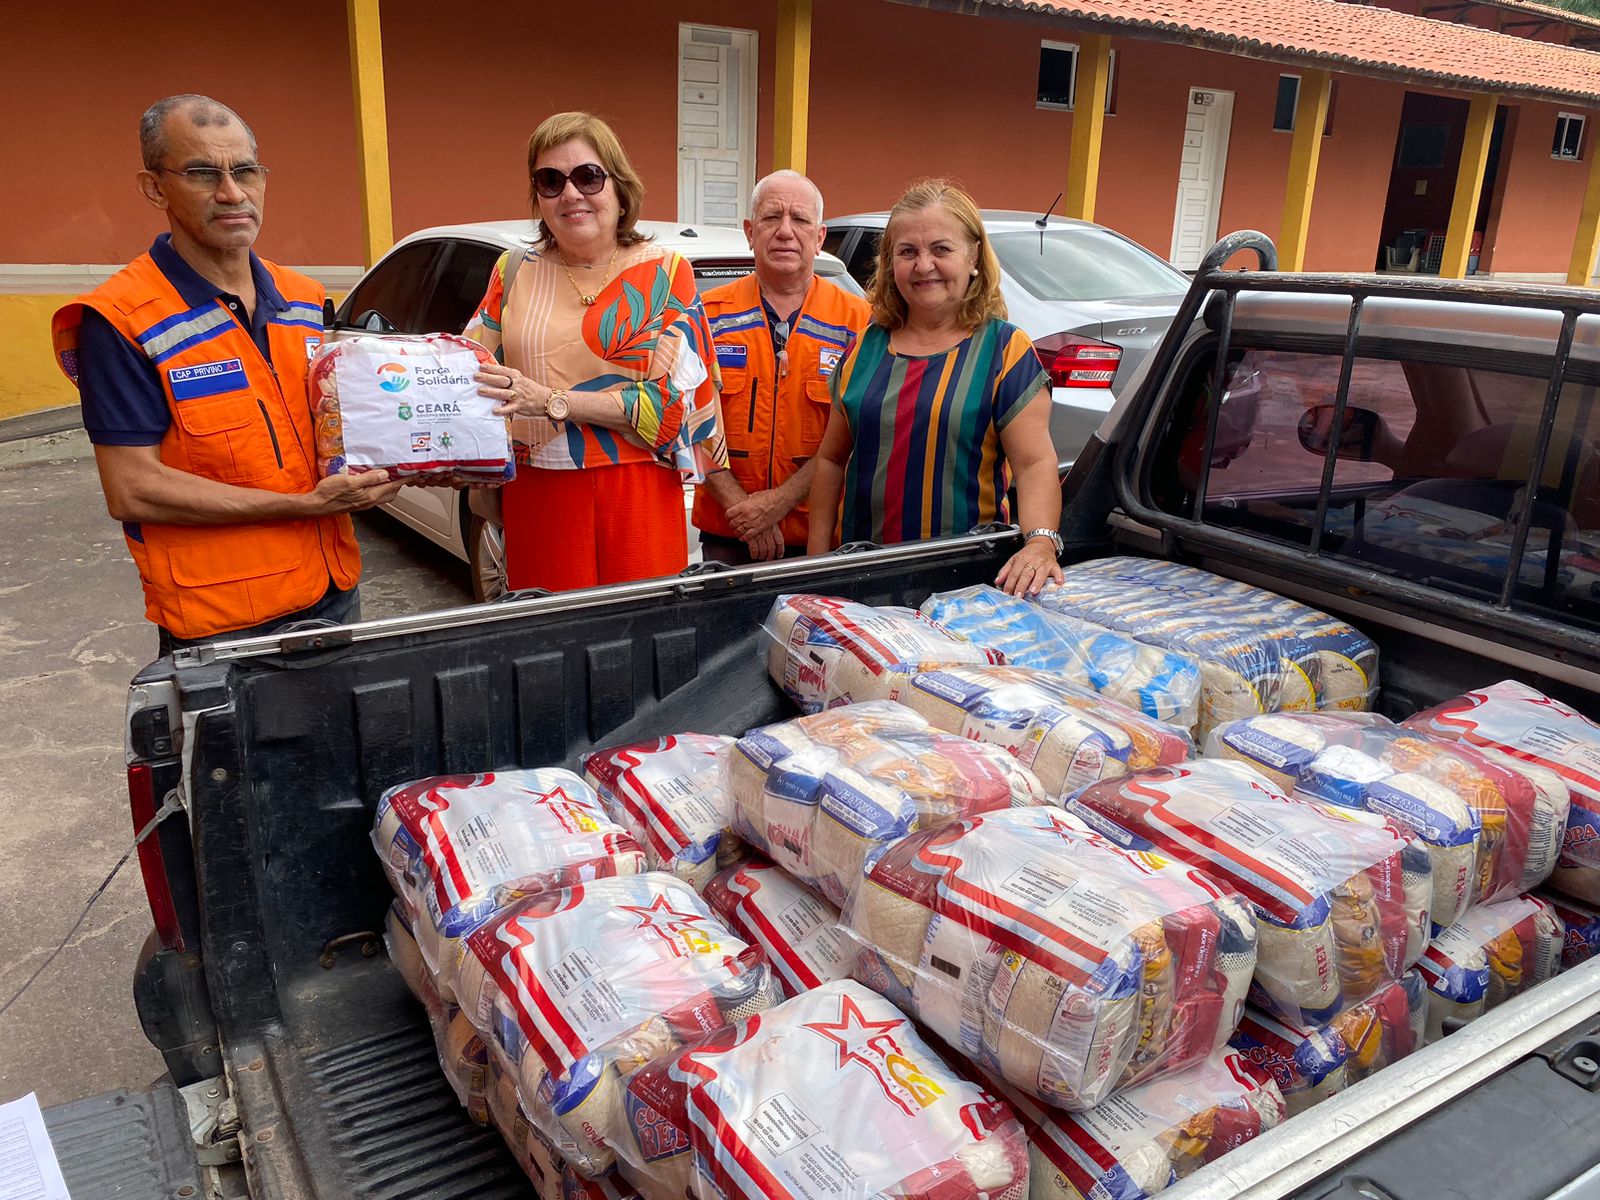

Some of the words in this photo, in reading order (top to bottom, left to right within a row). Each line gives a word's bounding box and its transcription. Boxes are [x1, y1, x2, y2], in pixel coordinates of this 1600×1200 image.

[1117, 327, 1147, 336] CITY
[176, 370, 191, 379] CAP
[194, 365, 223, 376] PRIVINO
[226, 362, 238, 371] A+
[415, 366, 451, 376] Força
[417, 375, 470, 386] Solidária
[416, 400, 461, 413] CEARÁ
[1563, 823, 1600, 844] OPA
[1384, 858, 1392, 901] Nordestin
